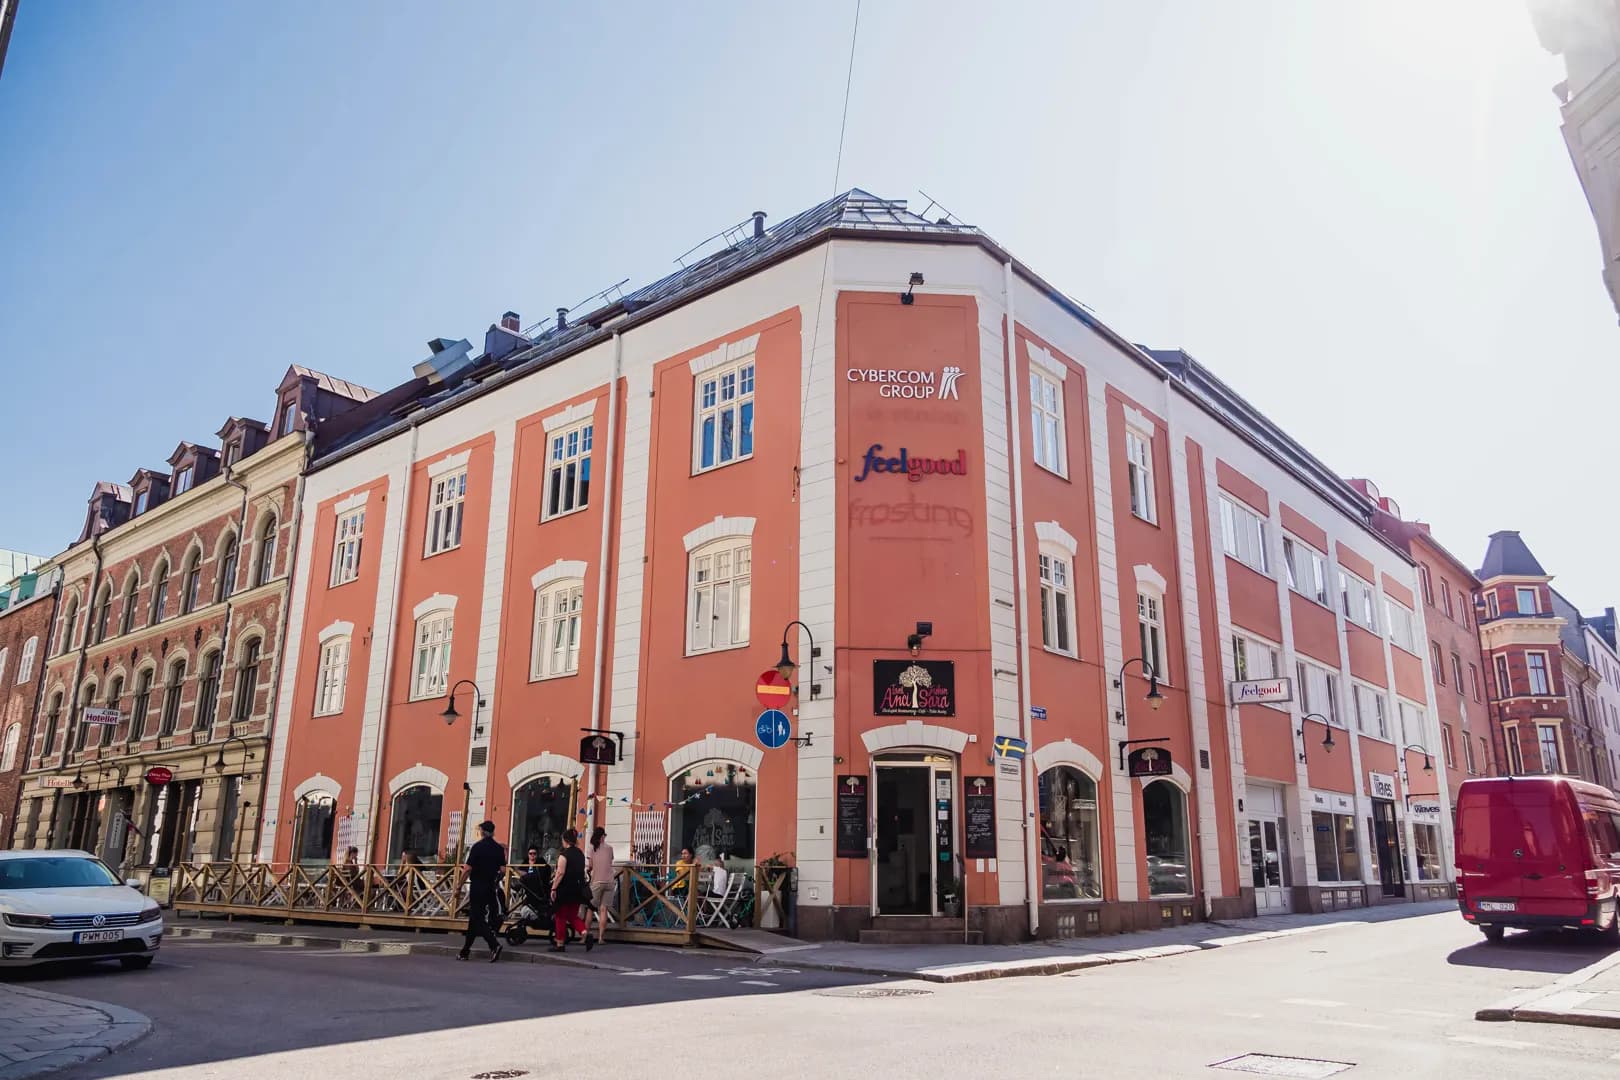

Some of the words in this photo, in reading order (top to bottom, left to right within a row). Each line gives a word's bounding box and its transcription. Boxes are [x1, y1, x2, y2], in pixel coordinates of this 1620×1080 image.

[847, 368, 935, 384] CYBERCOM
[879, 384, 935, 399] GROUP
[854, 443, 967, 482] feelgood
[919, 689, 950, 708] Sara
[1238, 682, 1281, 700] feelgood
[86, 713, 118, 724] Hotellet
[82, 932, 100, 941] PWM
[102, 931, 119, 940] 005
